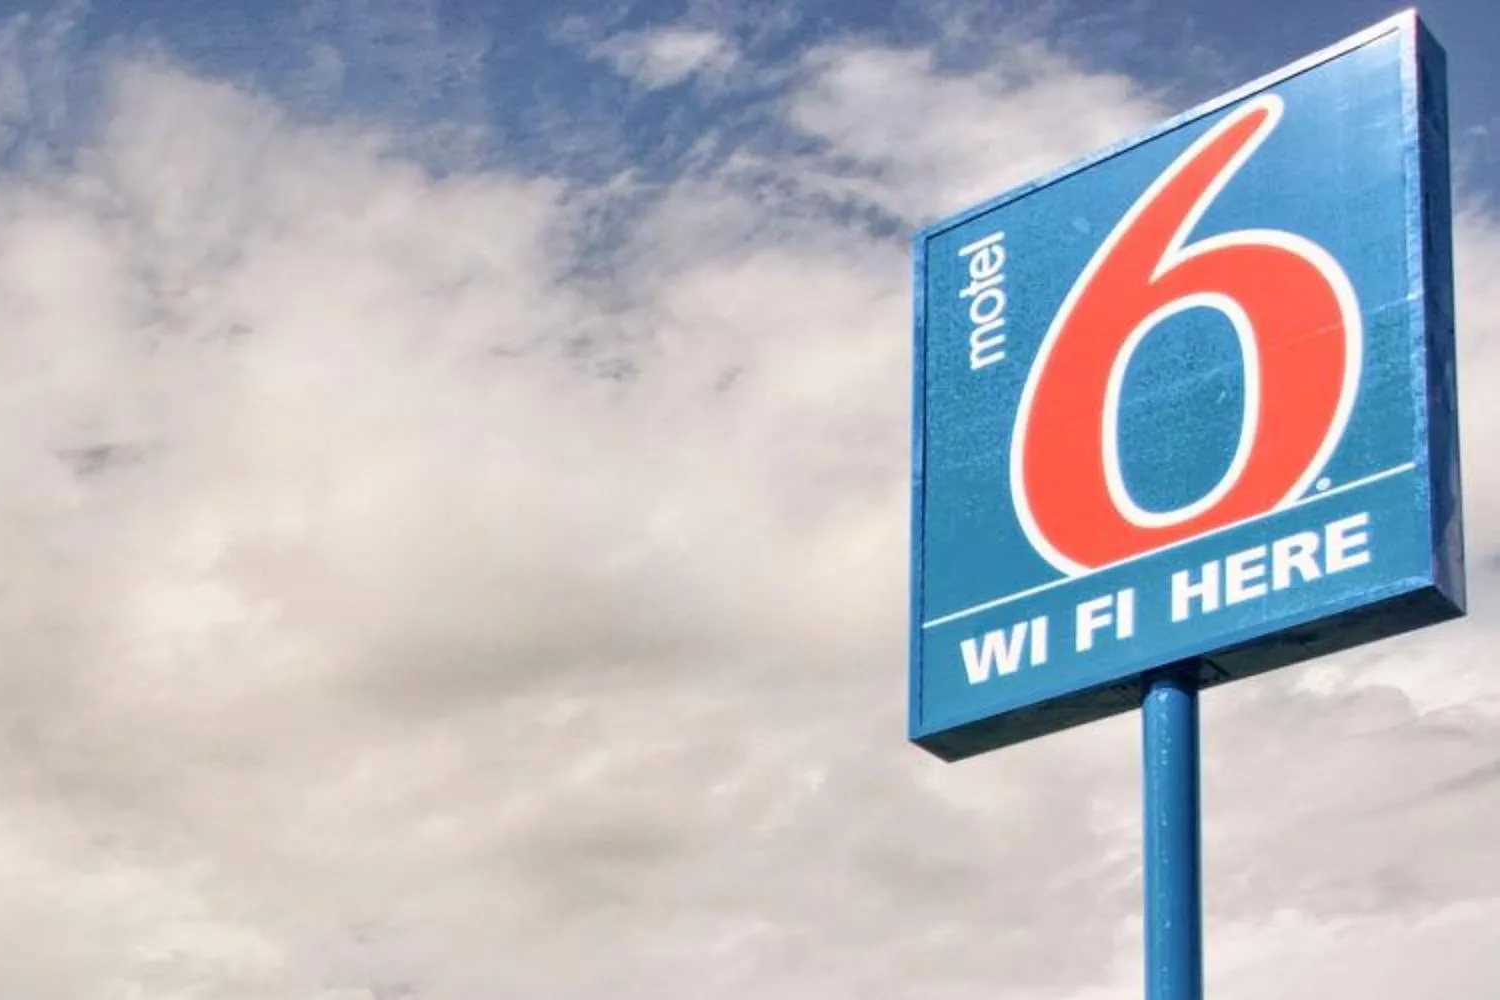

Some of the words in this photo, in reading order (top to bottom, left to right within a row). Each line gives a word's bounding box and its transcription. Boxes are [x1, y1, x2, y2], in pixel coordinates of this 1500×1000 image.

[958, 231, 1006, 370] motel
[1010, 93, 1364, 578] 6
[960, 615, 1049, 686] WI
[1075, 587, 1135, 652] FI
[1171, 511, 1371, 623] HERE
